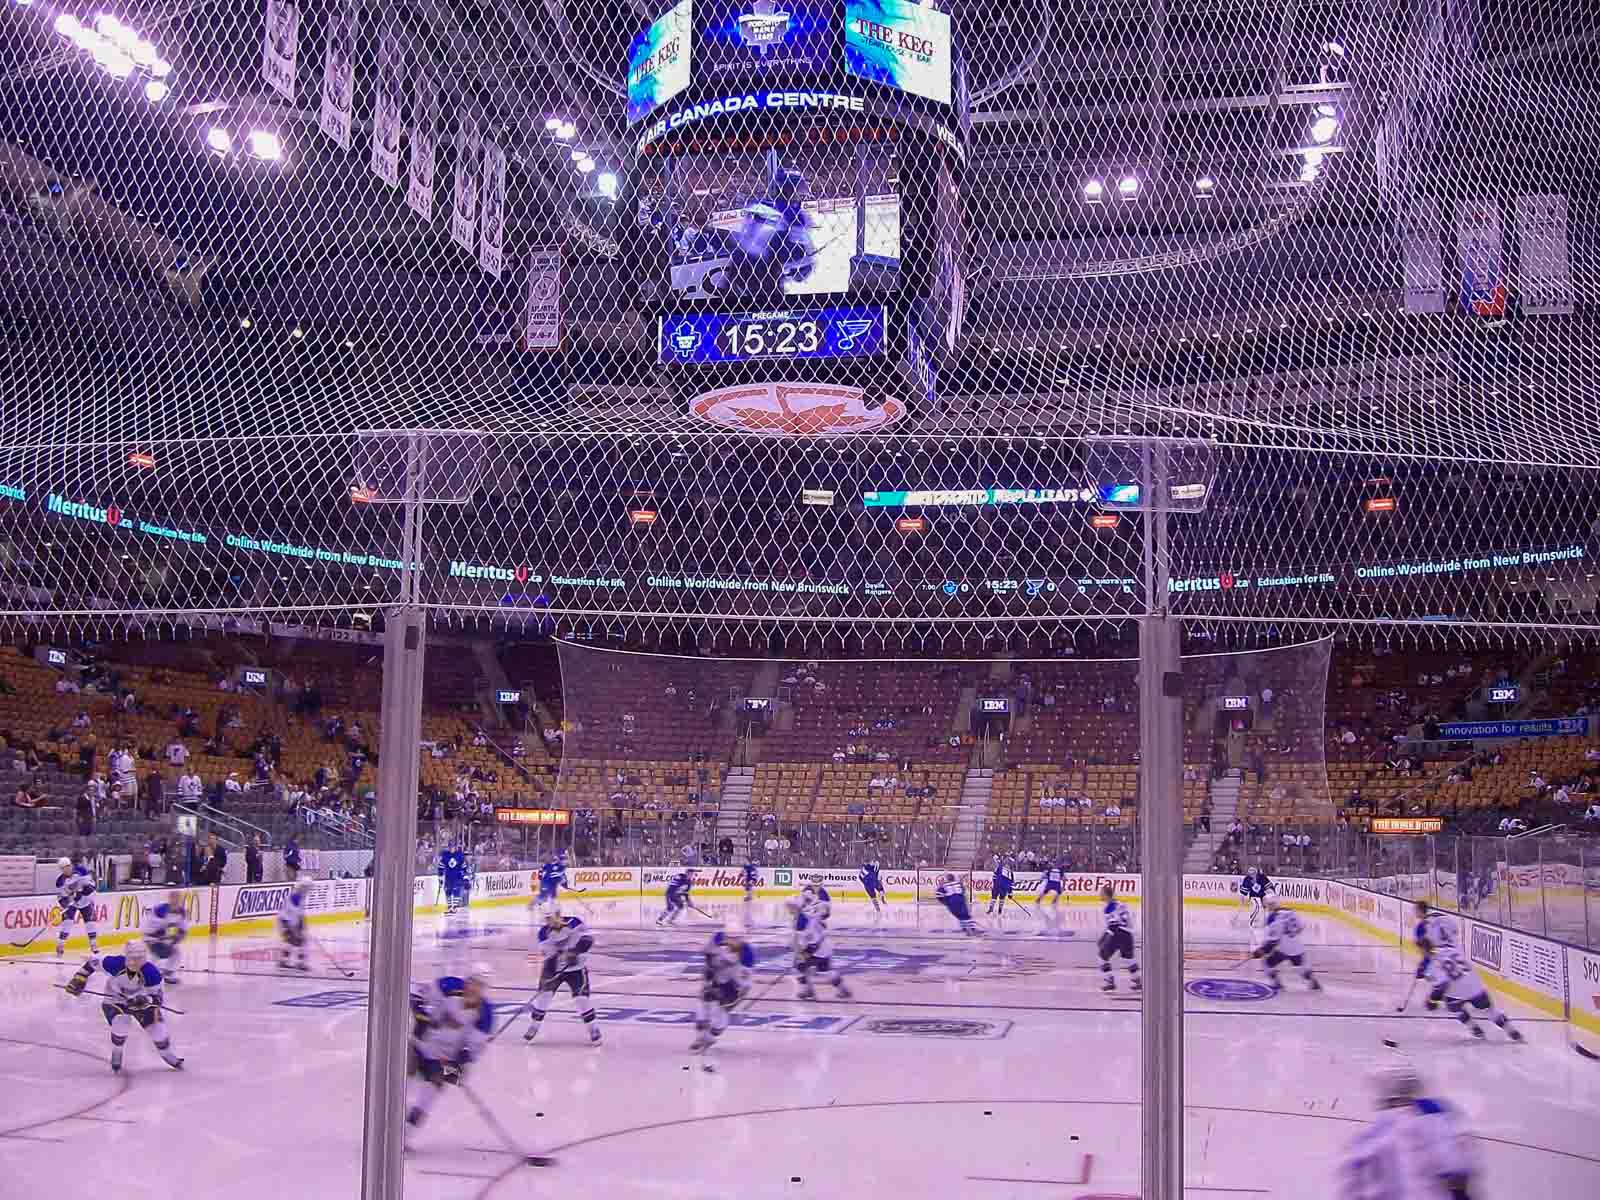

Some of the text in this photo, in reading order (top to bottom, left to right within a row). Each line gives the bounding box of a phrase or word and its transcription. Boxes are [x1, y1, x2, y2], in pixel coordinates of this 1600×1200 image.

[856, 19, 934, 57] THE KEG
[634, 55, 656, 81] THE
[658, 37, 680, 65] KEG
[646, 121, 668, 143] AIR
[670, 96, 758, 128] CANADA
[766, 92, 865, 111] CENTRE
[752, 311, 790, 321] PREGAME
[726, 321, 819, 354] 15:23
[140, 521, 178, 538] Education
[178, 529, 190, 541] for
[191, 531, 207, 543] life
[226, 534, 425, 571] Online Worldwide from New Brunswc
[1357, 546, 1583, 578] Online Worldwide from New Brunswick
[551, 576, 596, 586] Education
[597, 577, 610, 587] for
[611, 577, 625, 588] life
[647, 576, 849, 594] Online Worldwide from New Brunswick
[985, 580, 1018, 589] 15:23
[1257, 577, 1303, 587] Education
[1304, 574, 1319, 584] for
[1319, 573, 1335, 583] life
[960, 584, 968, 592] 0
[1046, 583, 1056, 592] 0
[1078, 586, 1086, 594] 0
[499, 692, 520, 702] IBM
[1492, 689, 1515, 700] IBM
[983, 700, 1005, 710] IBM
[1225, 697, 1247, 709] IBM
[1445, 725, 1498, 736] innovation
[1502, 723, 1515, 733] for
[574, 871, 633, 887] pizza pizza
[776, 872, 790, 883] TD
[886, 875, 932, 886] CANADA
[1095, 876, 1136, 892] Farm
[1184, 880, 1225, 891] BRAVIA
[1583, 956, 1600, 983] SPO
